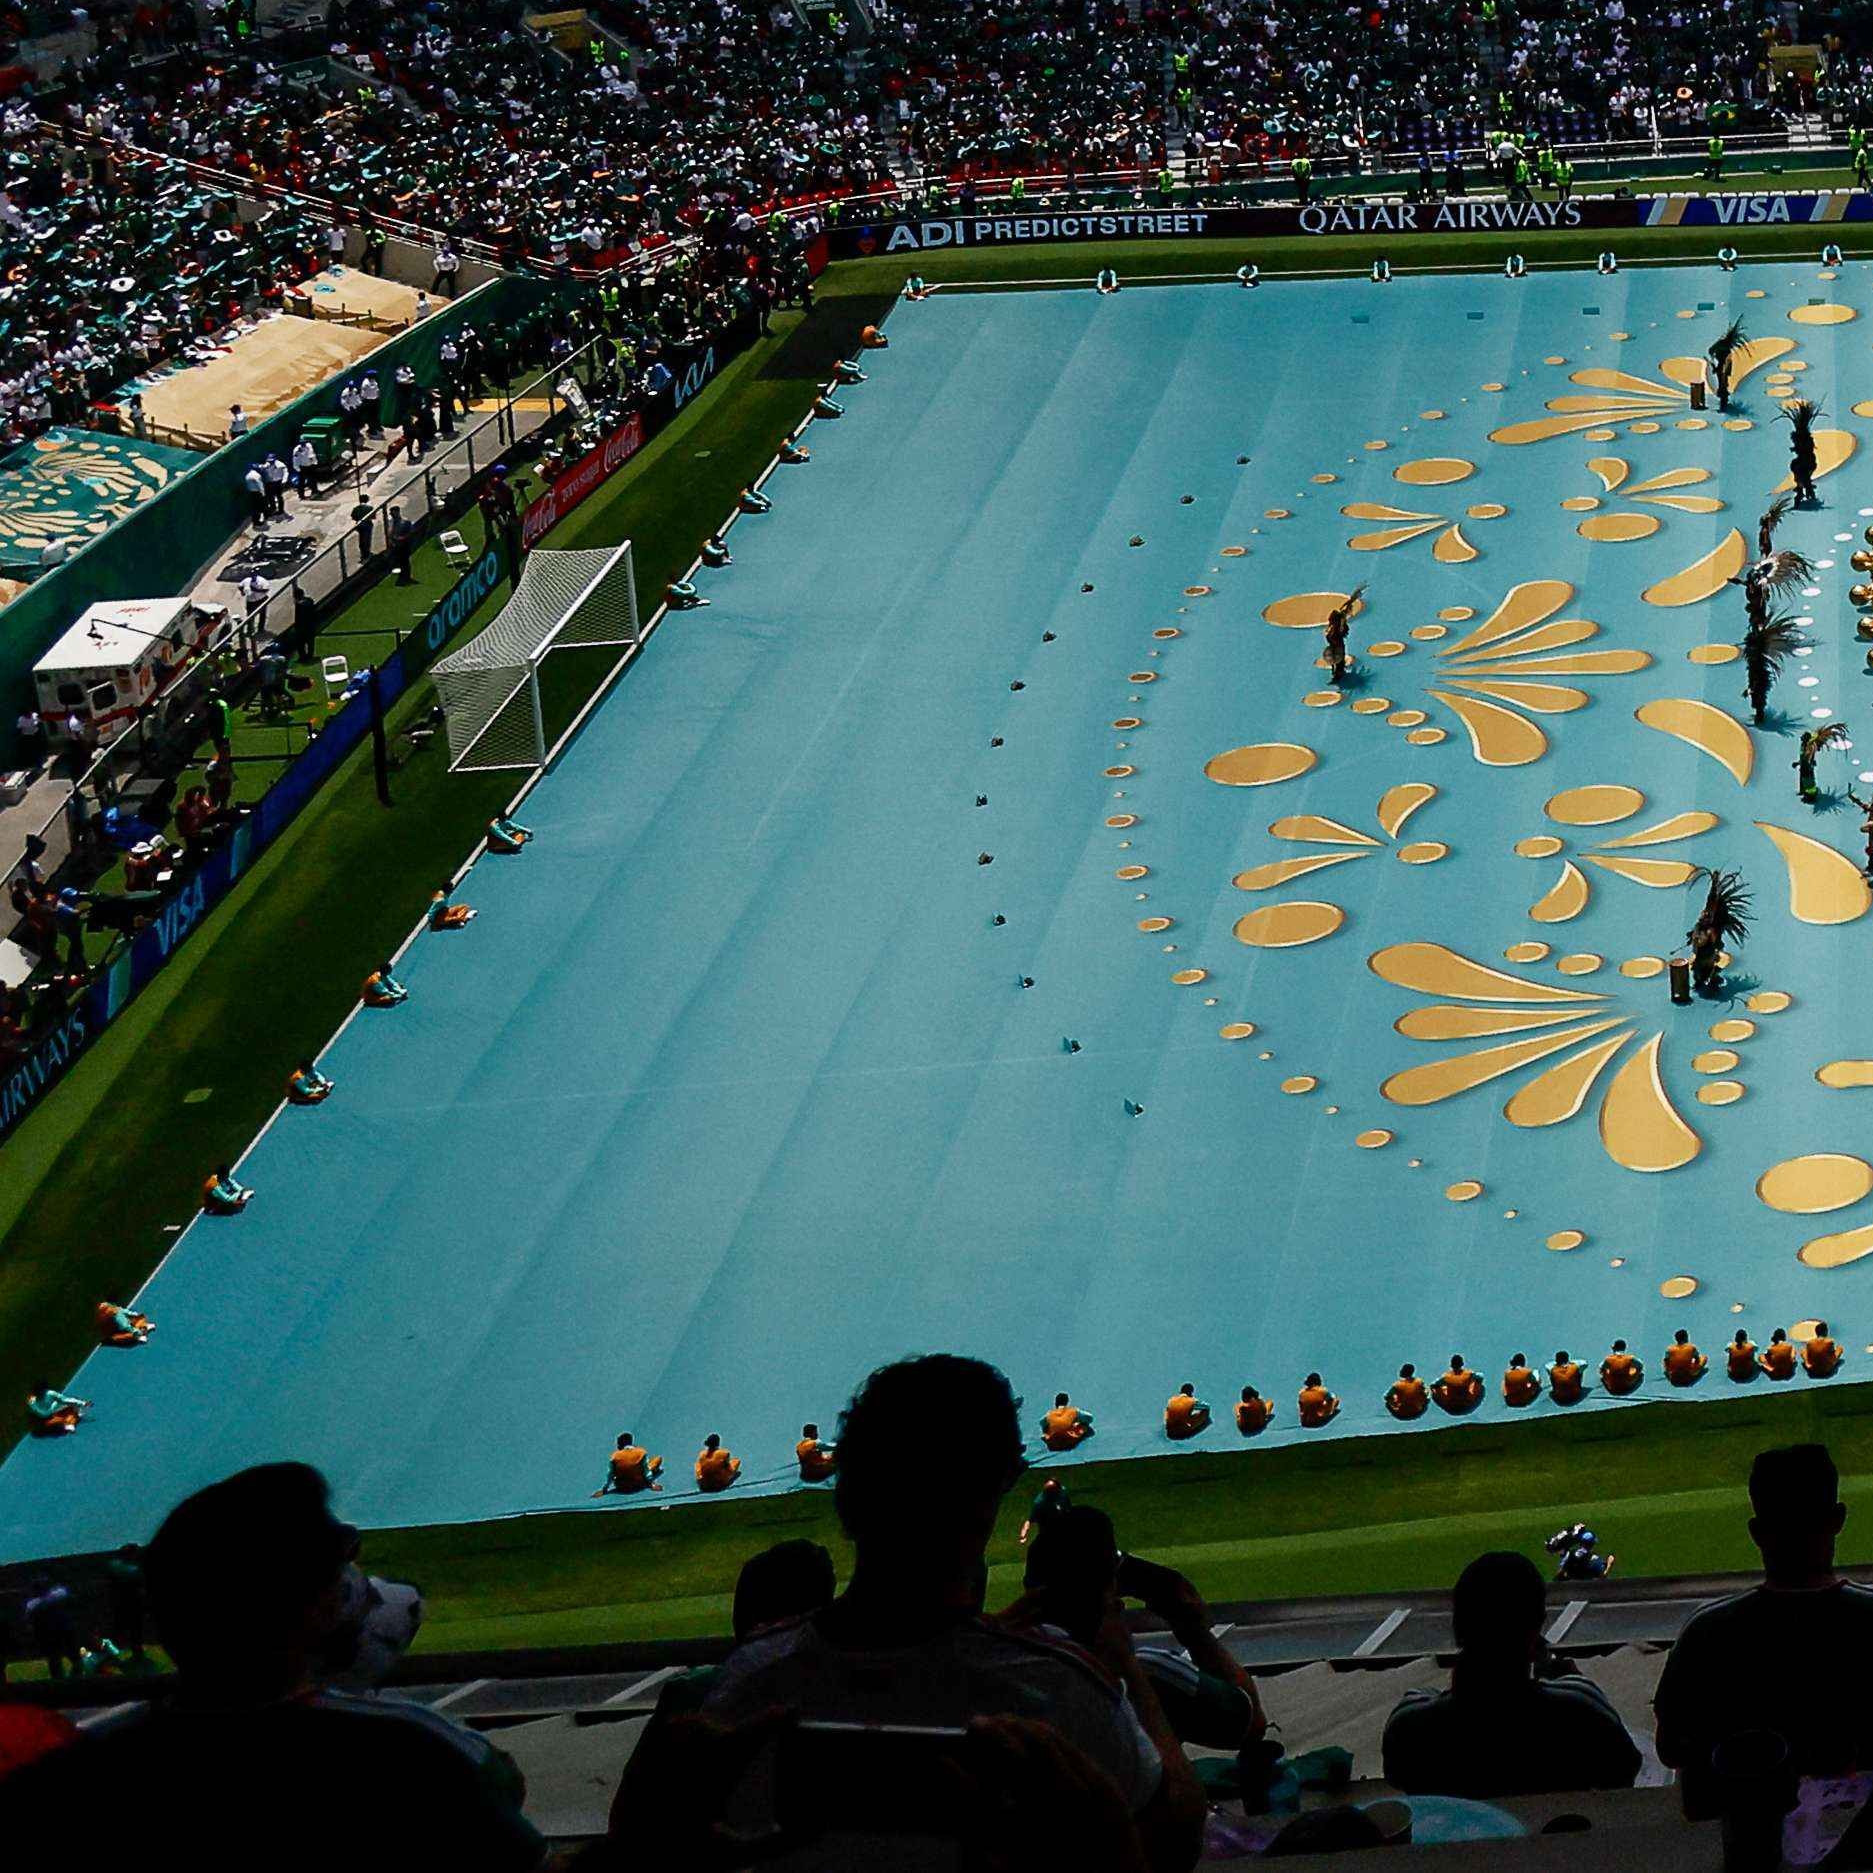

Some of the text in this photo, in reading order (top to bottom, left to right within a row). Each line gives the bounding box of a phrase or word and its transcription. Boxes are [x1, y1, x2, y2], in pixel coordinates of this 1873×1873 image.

[1300, 201, 1582, 234] QATAR AIRWAYS
[1711, 196, 1790, 224] VISA
[886, 213, 1208, 253] ADI PREDICTSTREET
[425, 550, 499, 652] aramco
